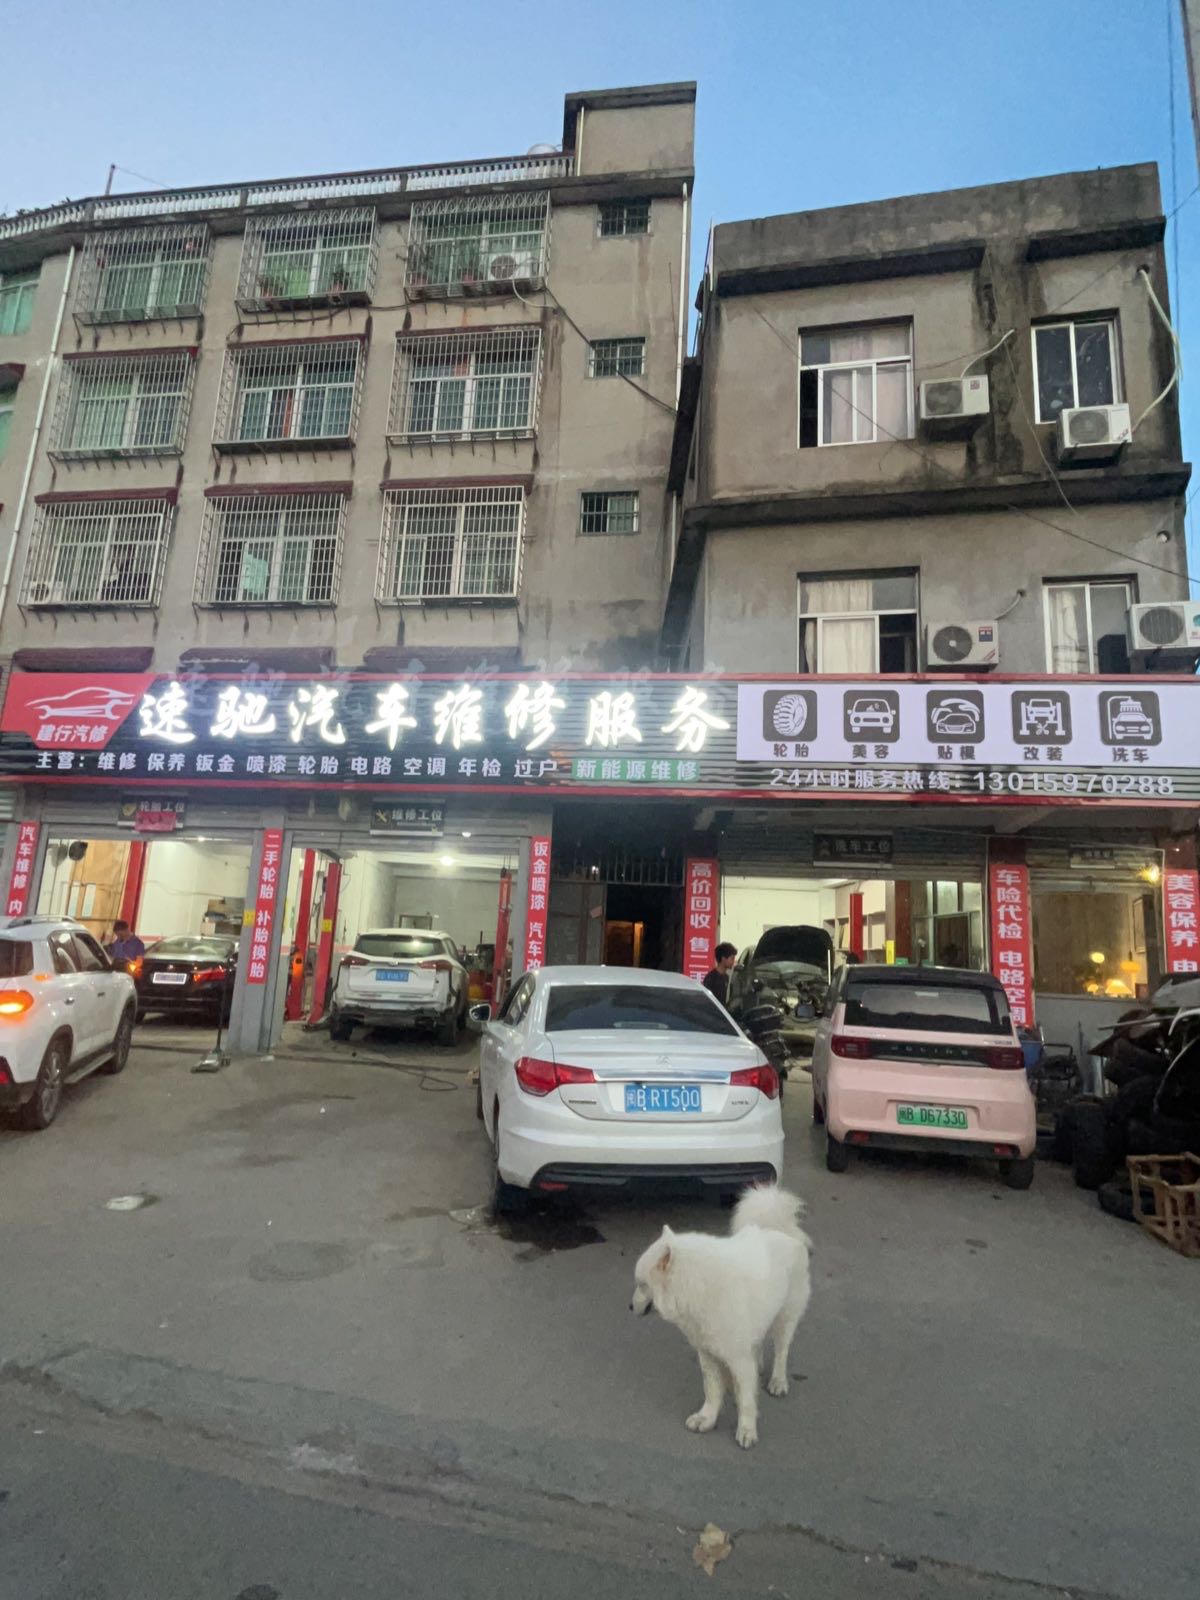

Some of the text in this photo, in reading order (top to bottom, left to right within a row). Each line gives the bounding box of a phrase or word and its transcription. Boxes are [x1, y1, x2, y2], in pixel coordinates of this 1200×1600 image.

[138, 682, 730, 752] 速驰汽车维修服务
[97, 752, 137, 771] 维修
[146, 753, 186, 772] 保养
[195, 753, 236, 773] 钣金
[246, 754, 287, 774] 喷漆
[298, 755, 339, 775] 轮胎
[350, 756, 392, 776] 电路
[403, 756, 447, 777] 空调
[457, 757, 502, 778] 年检
[513, 758, 559, 779] 过户
[575, 759, 699, 780] 新能源维修
[773, 743, 810, 759] 轮胎
[851, 743, 890, 759] 美容
[1023, 746, 1063, 761] 改装
[1112, 747, 1149, 763] 洗车
[13, 826, 36, 889] 汽车维修
[259, 833, 282, 901] 二手轮胎
[530, 840, 549, 912] 钣金喷漆
[689, 862, 712, 929] 高价回收
[995, 869, 1024, 940] 车险代检
[1167, 874, 1199, 948] 美容保养
[249, 909, 272, 979] 补胎换胎
